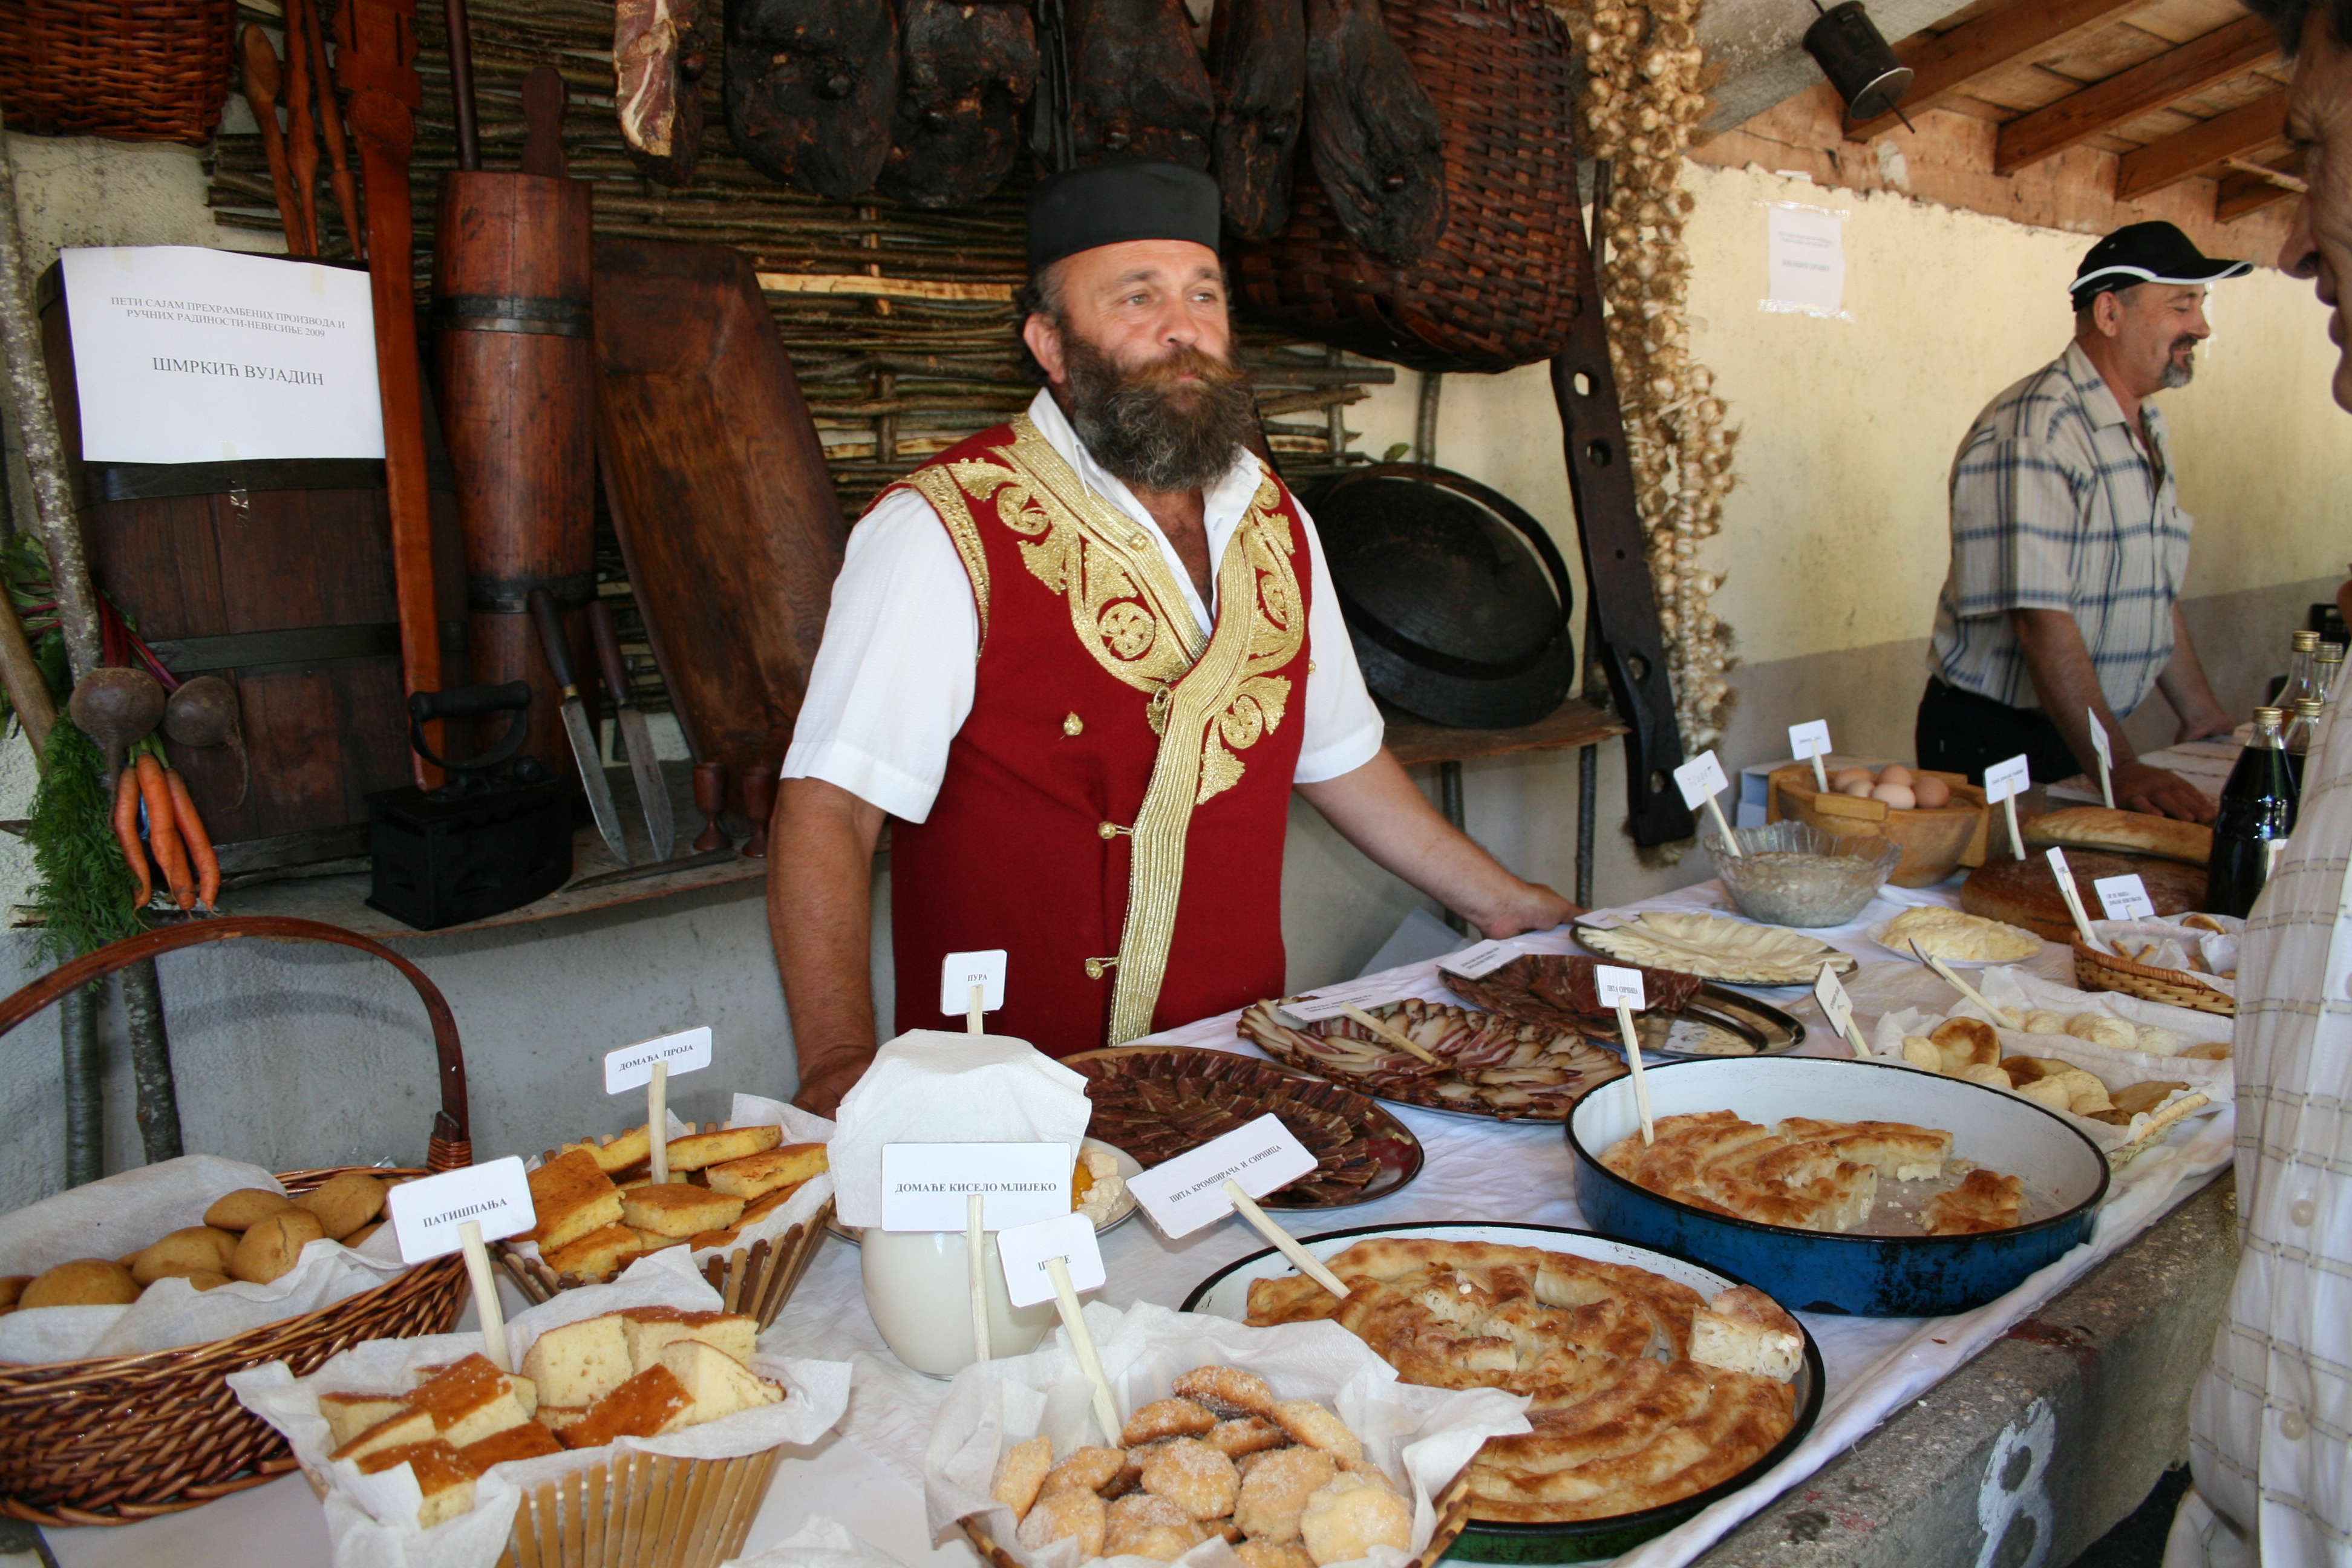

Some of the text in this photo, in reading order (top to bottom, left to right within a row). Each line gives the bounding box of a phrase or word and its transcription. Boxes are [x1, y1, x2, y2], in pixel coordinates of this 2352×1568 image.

[111, 296, 345, 329] ПЕТИ САЈАМ ПРЕХРАМБЕНИХ ПРОИЗВОДА И
[126, 309, 325, 337] РУЧНИХ РАДИНОСТИ-НЕВЕСИЊЕ 2009
[152, 357, 324, 385] ШМРКИЋ ВУЈАДИН
[967, 973, 988, 982] ПУРА
[619, 1044, 694, 1072] ДОМАЋА ПРОЈА
[895, 1182, 1057, 1194] ДОМАЋЕ КИСЕЛО МЛИЈЕКО
[1169, 1145, 1282, 1203] ПИТА КРОМПИРАЧА И СИРНИЦА
[422, 1197, 508, 1227] ПАТИШПАЊА
